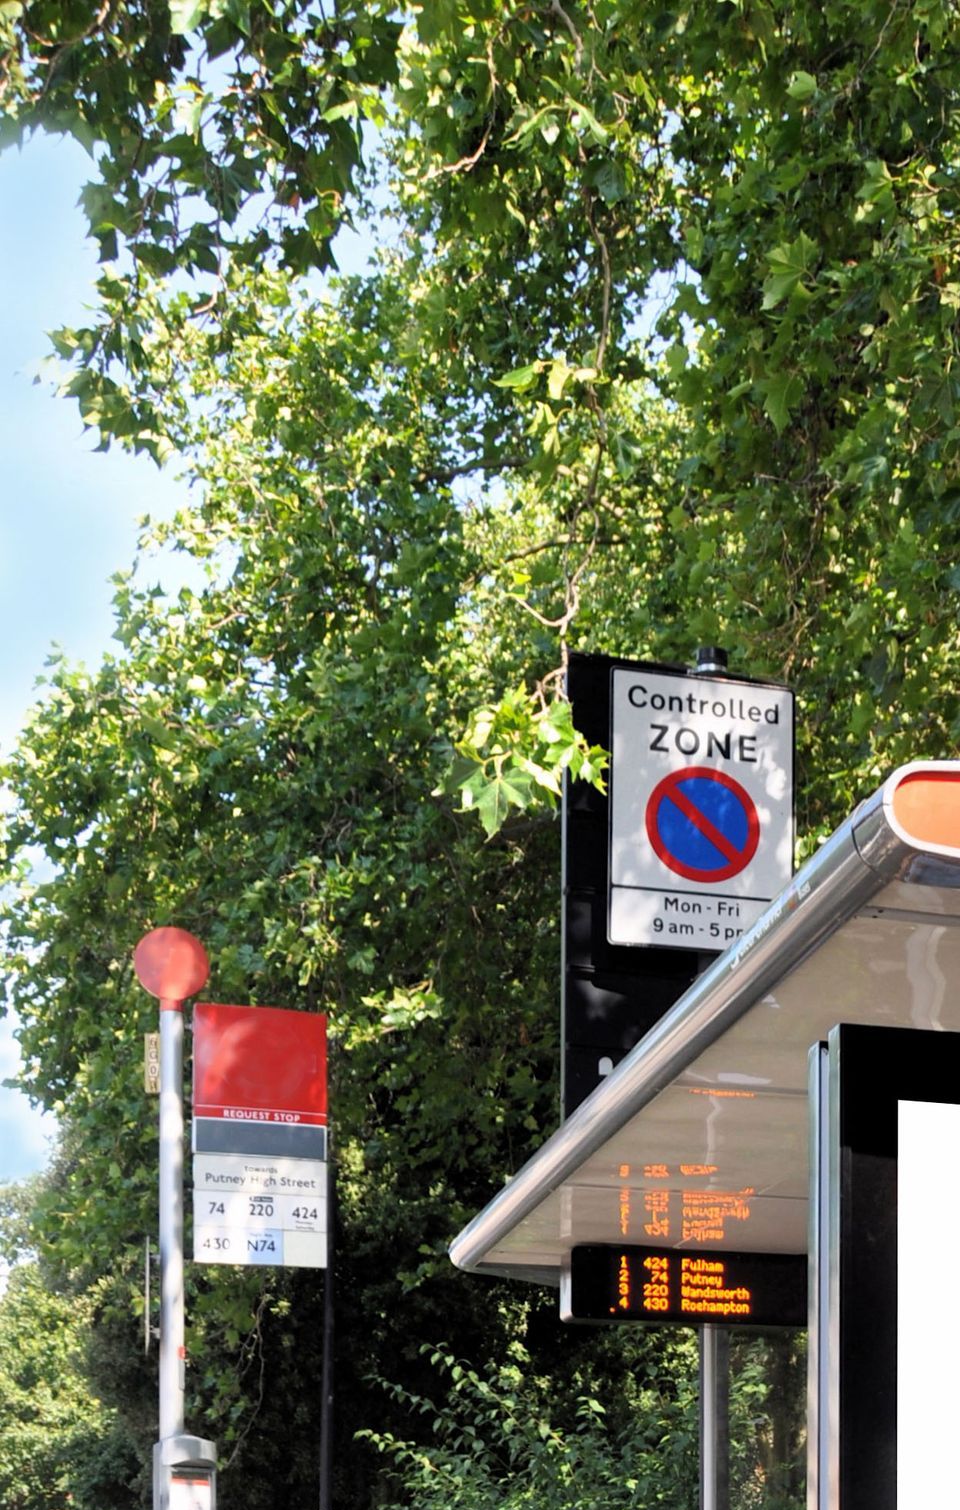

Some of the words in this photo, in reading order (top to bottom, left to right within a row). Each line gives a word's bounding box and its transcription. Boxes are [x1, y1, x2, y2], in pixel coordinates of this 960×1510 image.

[627, 685, 780, 725] Controlled
[650, 724, 758, 763] ZONE
[664, 896, 702, 914] Mon
[717, 901, 740, 917] Fri
[653, 918, 664, 933] 9
[668, 922, 694, 935] am
[710, 922, 720, 937] 5
[223, 1109, 270, 1120] REQUEST
[273, 1112, 301, 1123] STOP
[244, 1165, 278, 1174] Towards
[205, 1172, 246, 1186] Putney
[250, 1176, 277, 1188] Hgh
[280, 1177, 316, 1189] Street
[209, 1201, 225, 1215] 74
[249, 1203, 274, 1217] 220
[292, 1206, 318, 1220] 424
[202, 1237, 230, 1250] 430
[247, 1239, 276, 1252] N74
[620, 1255, 627, 1268] 1
[643, 1257, 668, 1269] 424
[681, 1258, 724, 1272] Fulham
[619, 1269, 629, 1281] 2
[651, 1270, 668, 1283] 74
[681, 1272, 723, 1288] Putney
[619, 1282, 629, 1295] 3
[643, 1284, 668, 1296] 220
[681, 1285, 750, 1300] Wandsworth
[619, 1296, 629, 1309] 4
[643, 1298, 668, 1310] 430
[681, 1299, 750, 1315] Roehampton
